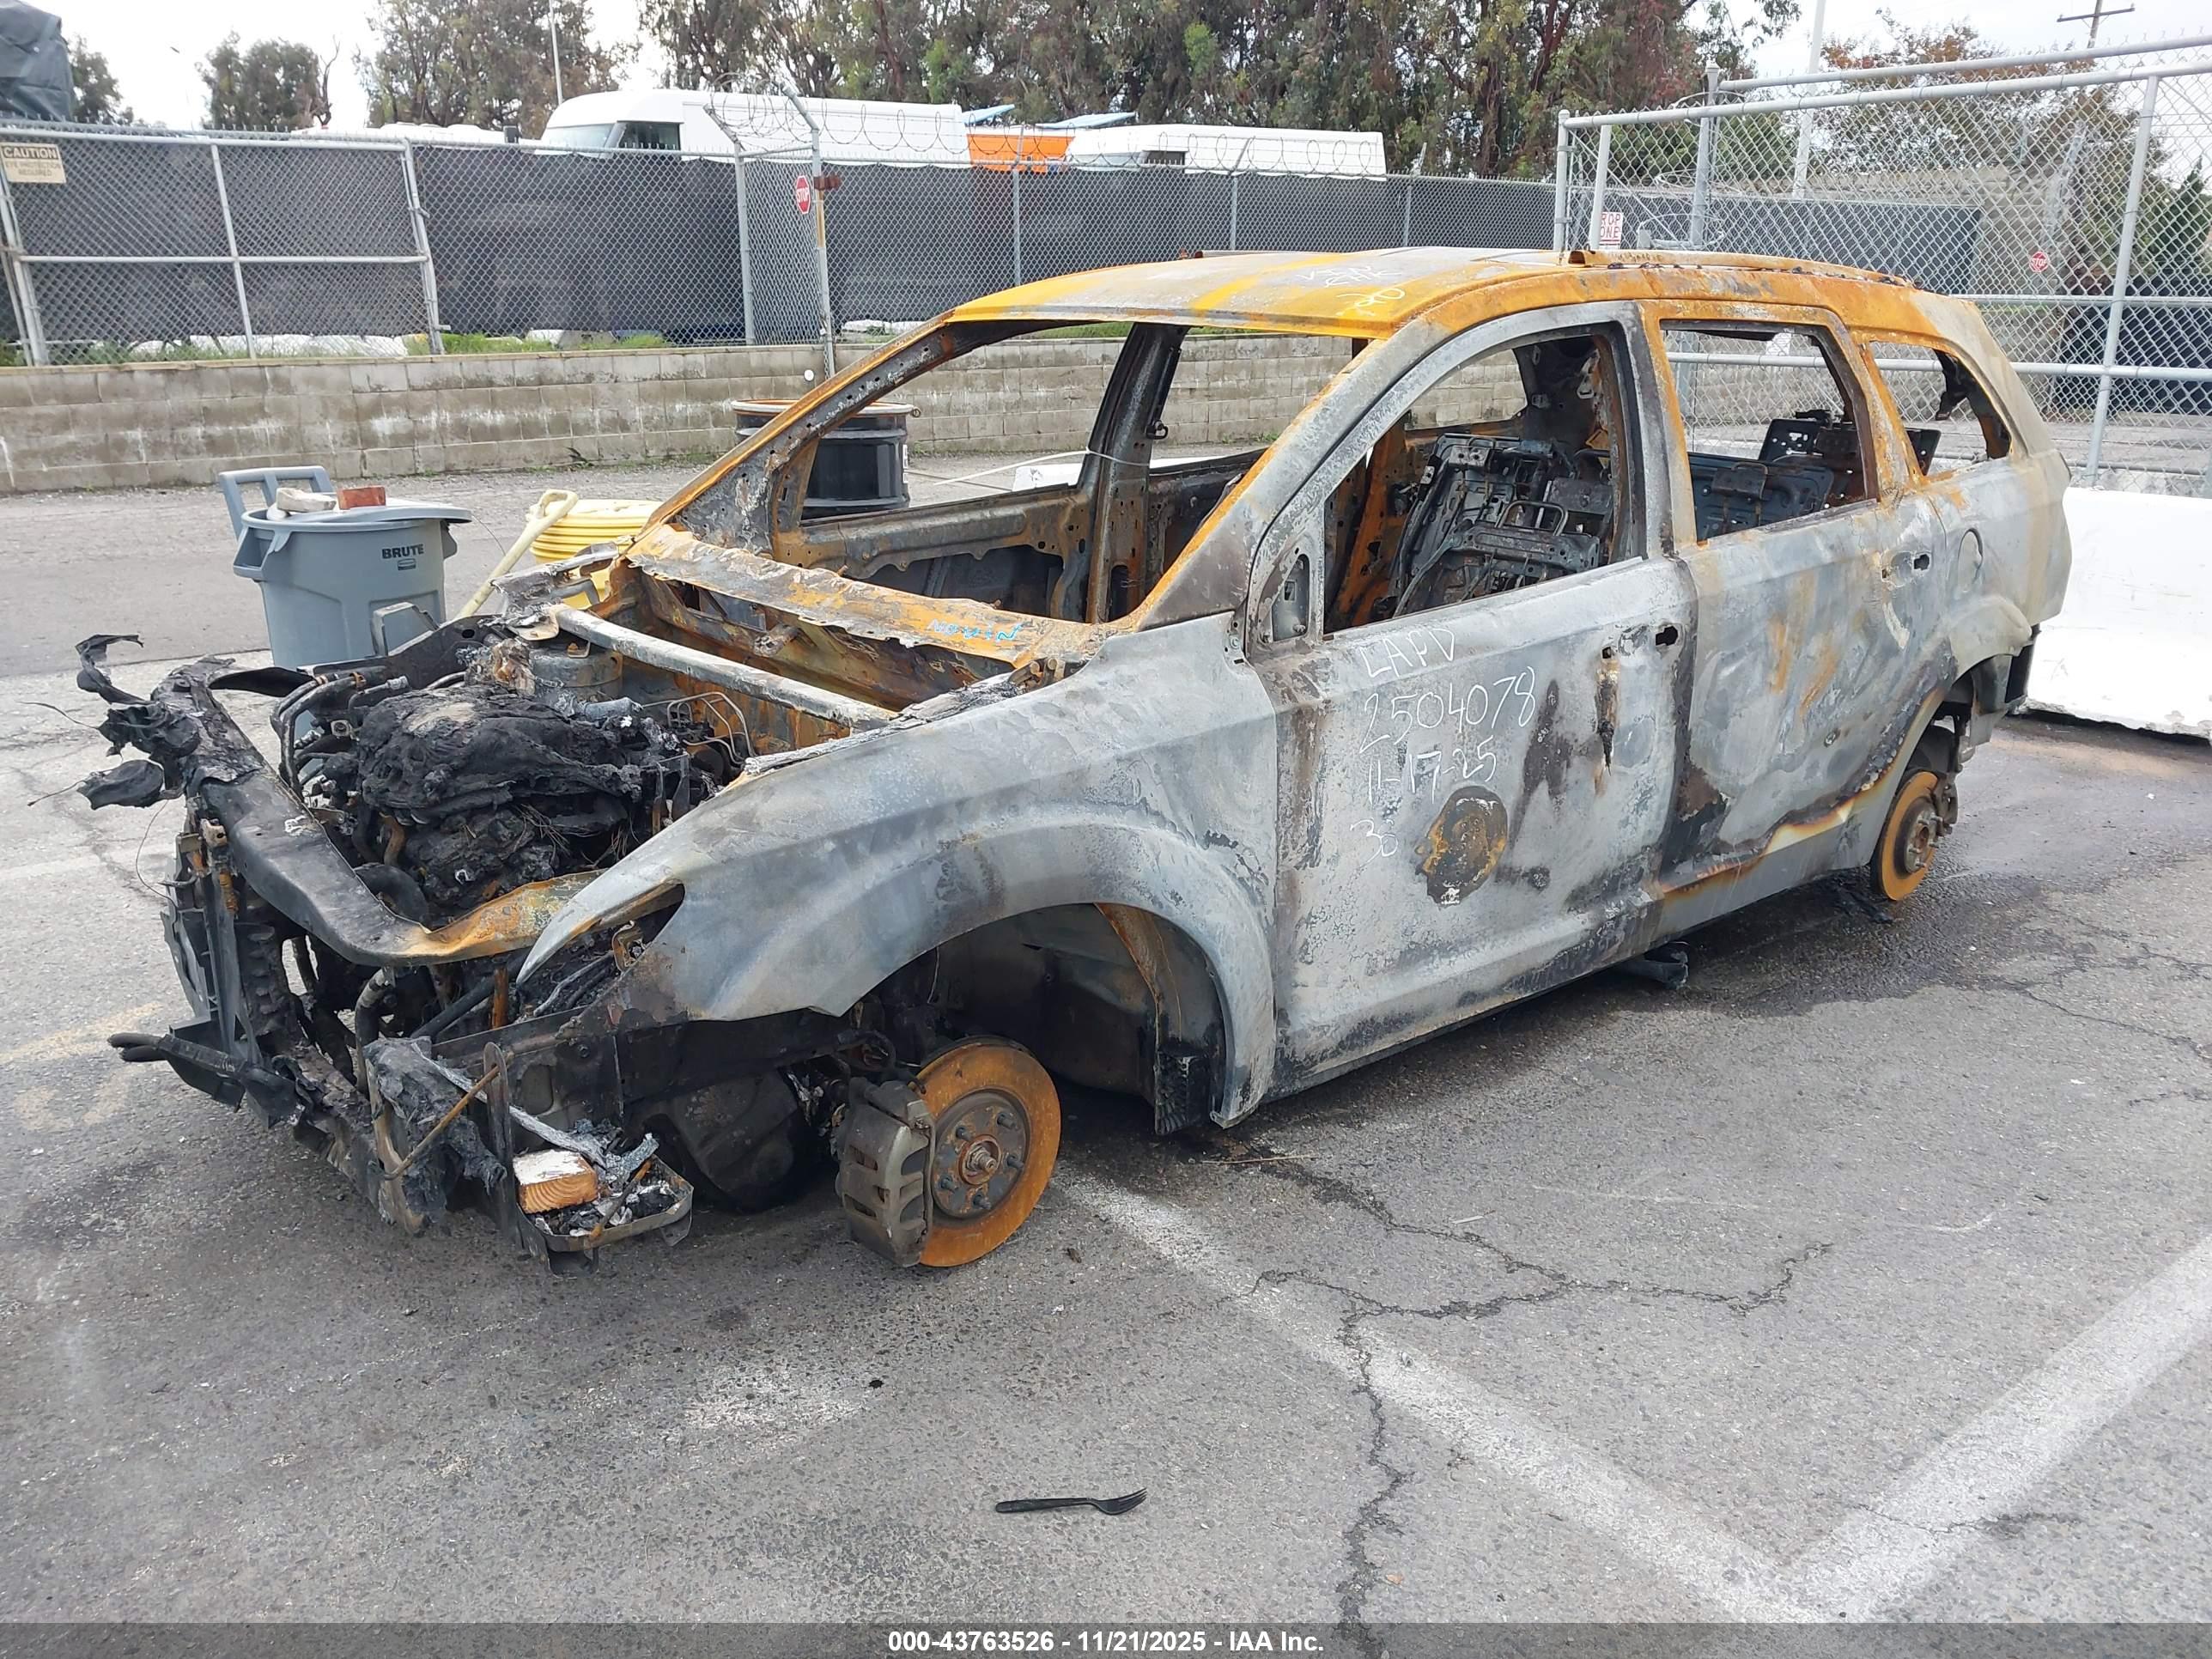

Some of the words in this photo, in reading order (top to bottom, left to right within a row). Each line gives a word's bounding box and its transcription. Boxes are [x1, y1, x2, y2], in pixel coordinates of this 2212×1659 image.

[4, 147, 57, 158] CAUTION
[797, 187, 810, 203] STOP
[381, 544, 424, 559] BRUTE
[1359, 666, 1536, 754] 2504078
